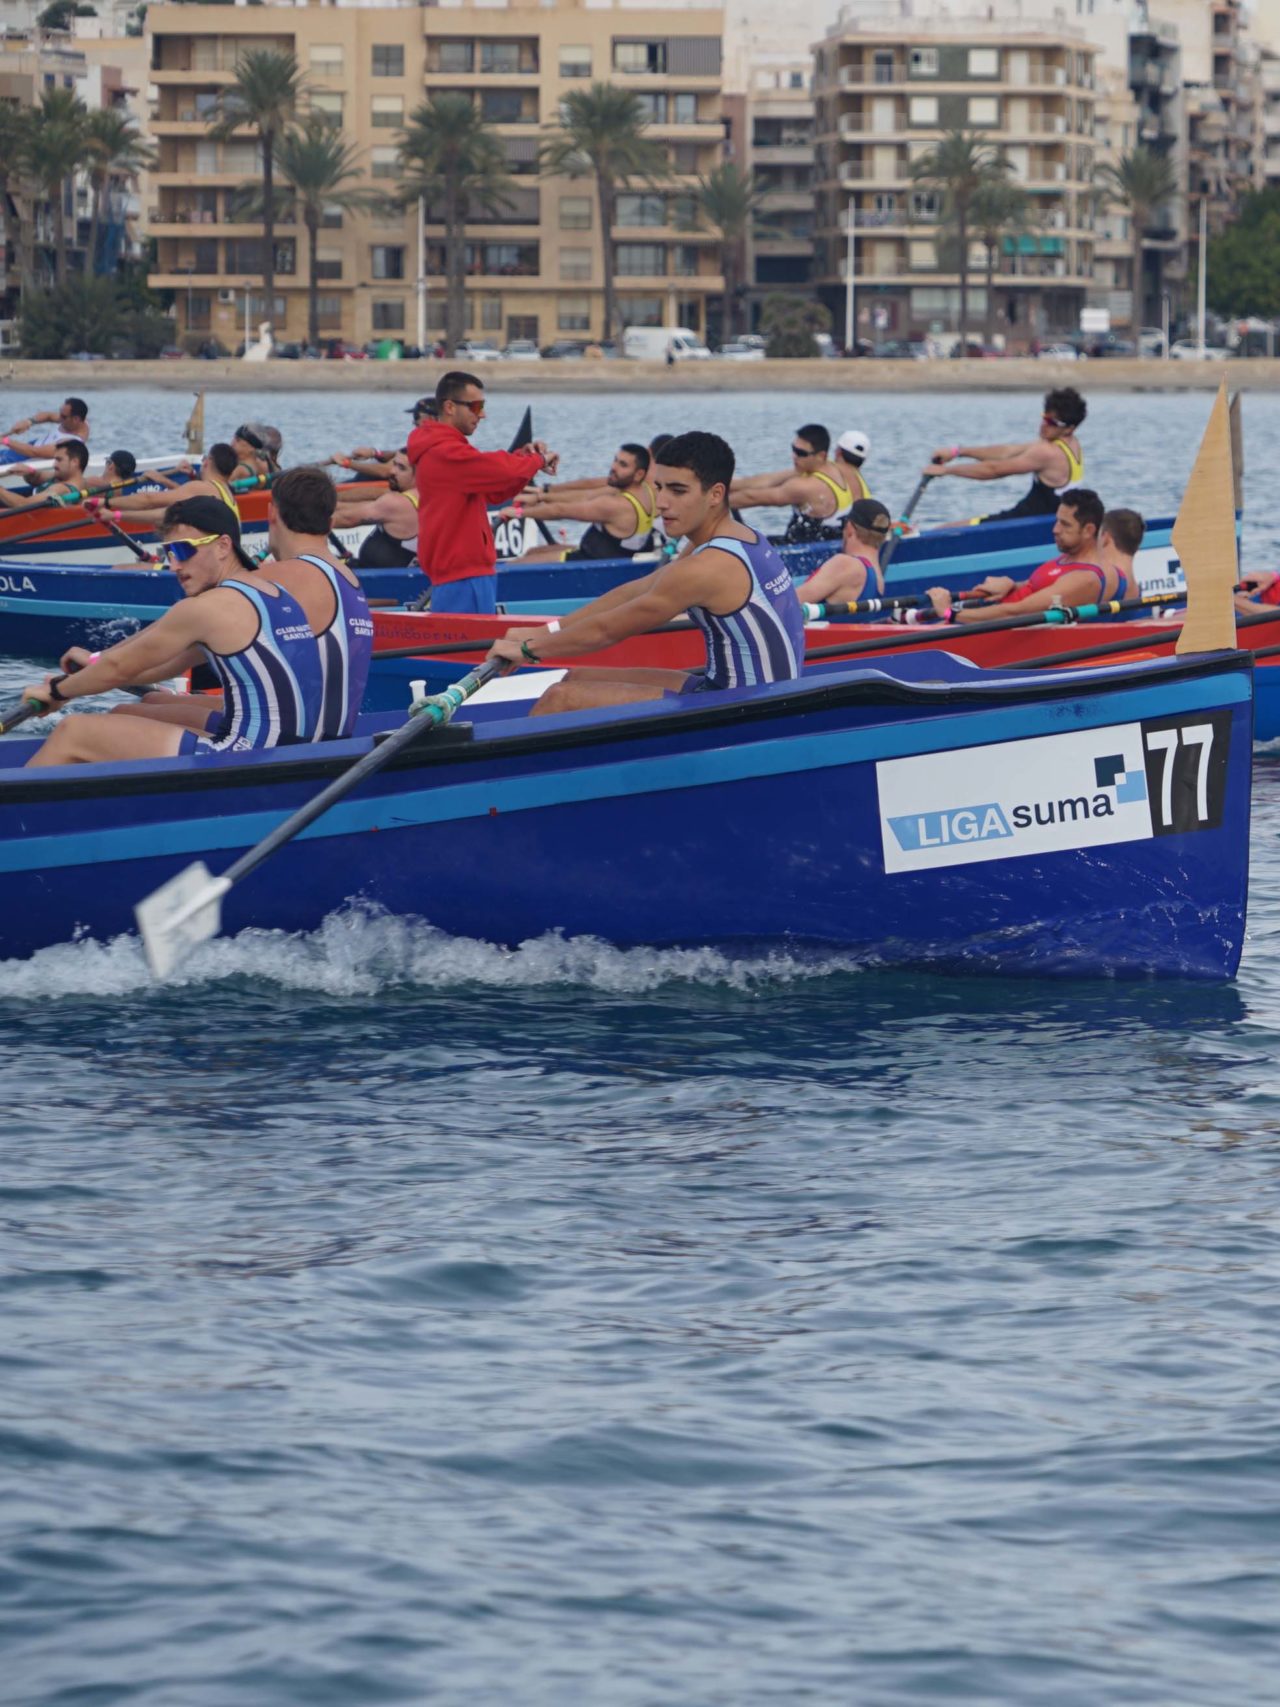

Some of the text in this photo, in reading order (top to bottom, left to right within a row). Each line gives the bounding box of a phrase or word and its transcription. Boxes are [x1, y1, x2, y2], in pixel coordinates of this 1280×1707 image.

[494, 517, 523, 557] 46
[1139, 576, 1176, 591] uma
[275, 626, 296, 635] CLUB
[1146, 723, 1214, 826] 77
[918, 793, 1114, 847] LIGA suma
